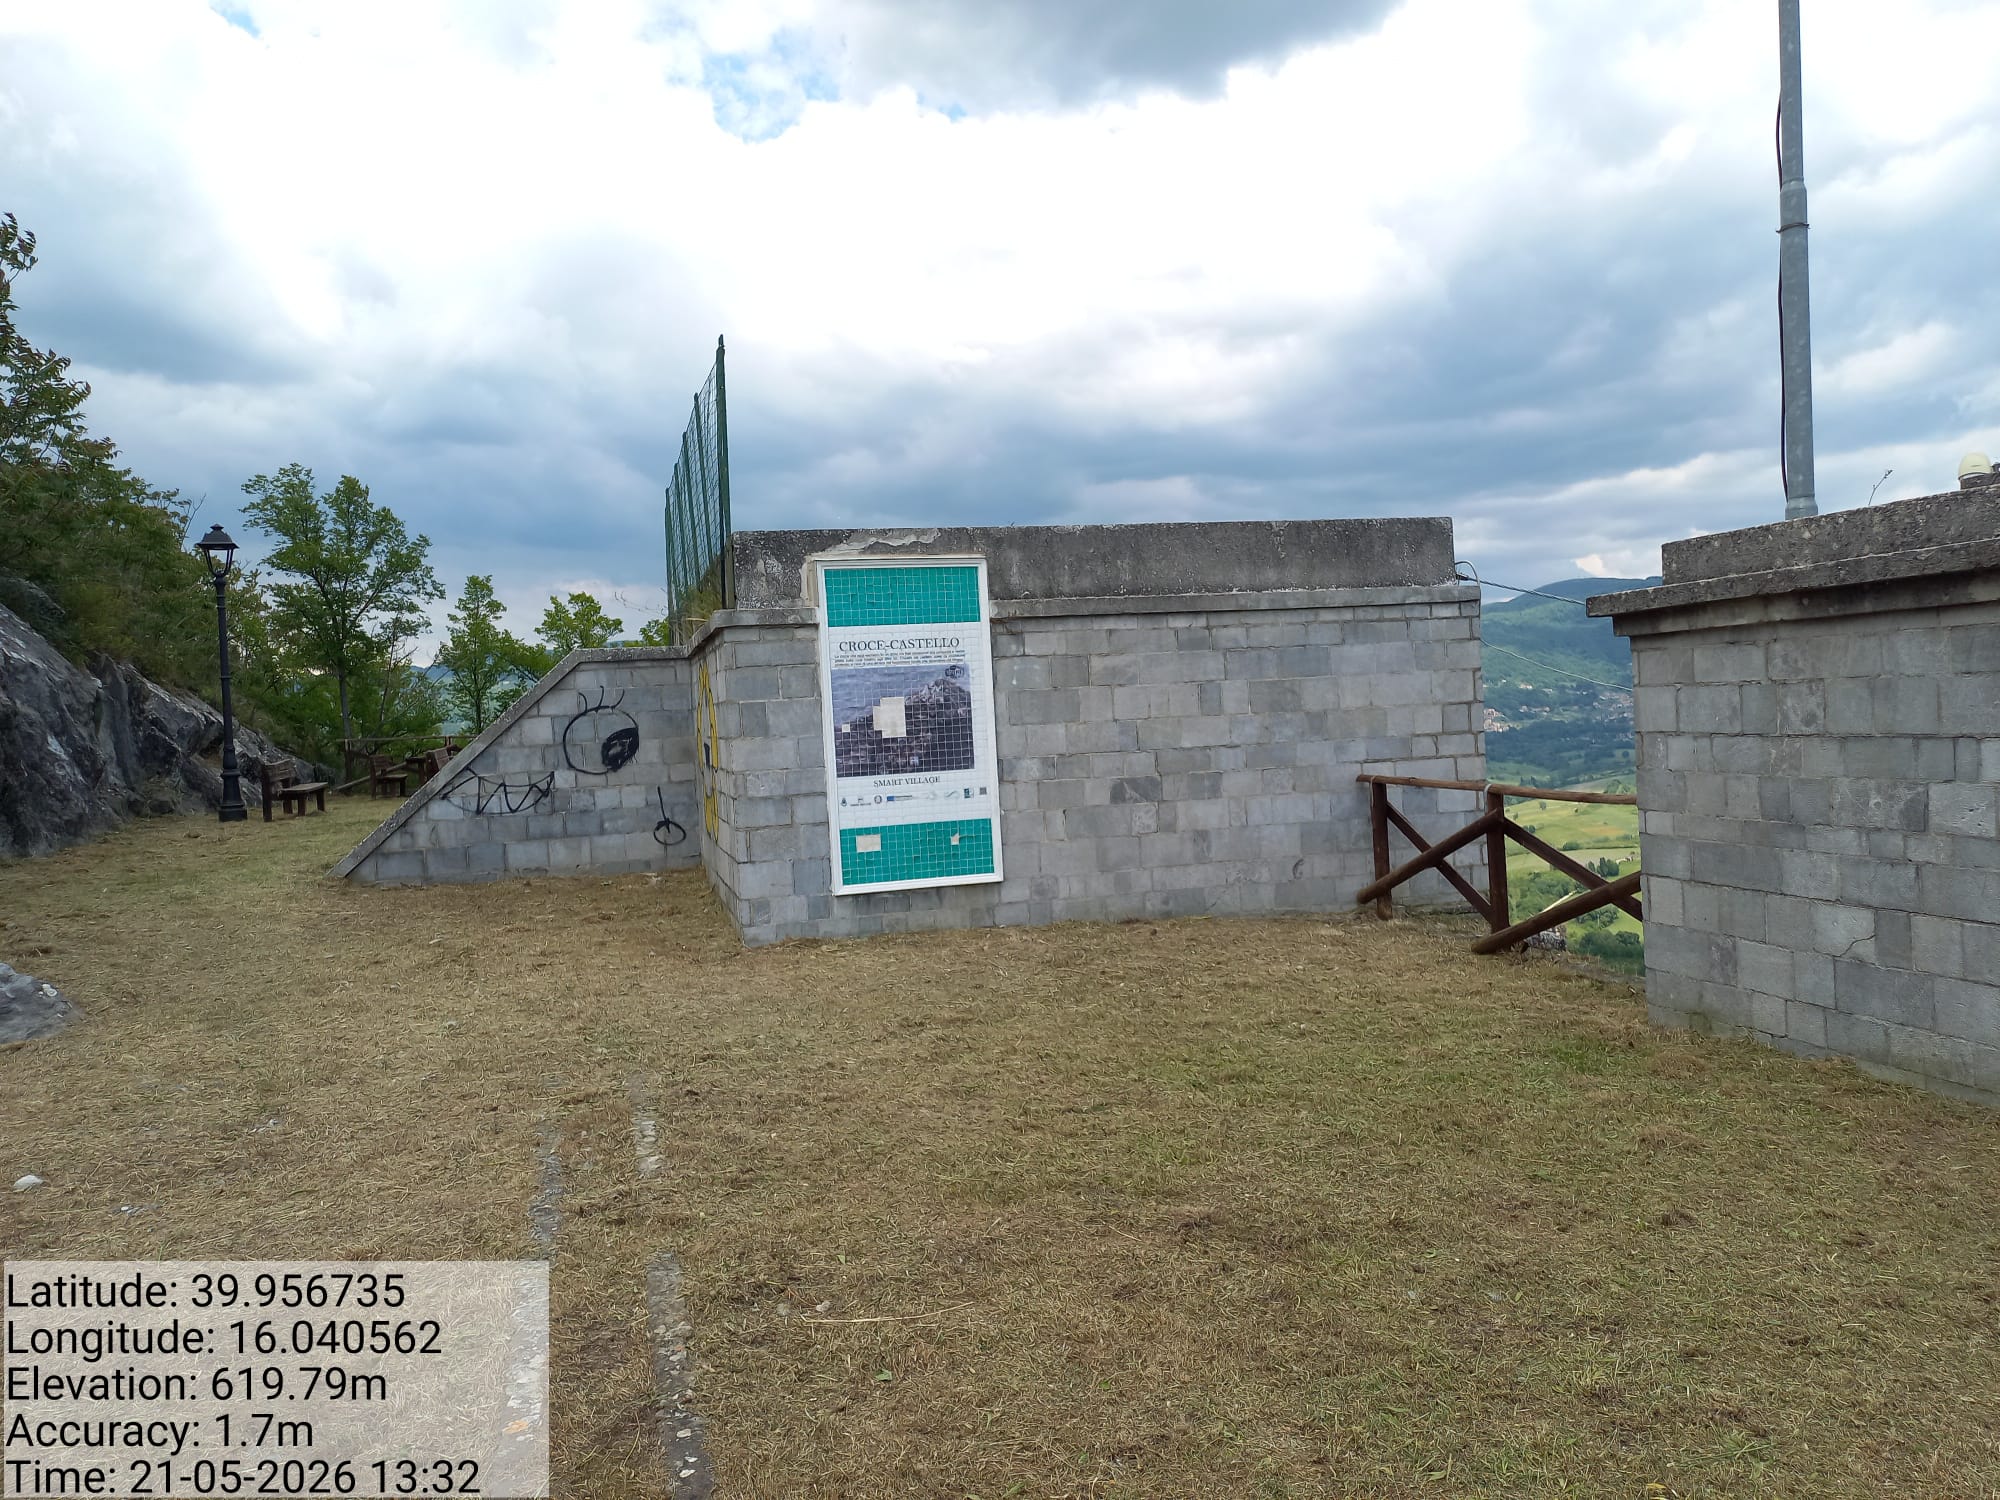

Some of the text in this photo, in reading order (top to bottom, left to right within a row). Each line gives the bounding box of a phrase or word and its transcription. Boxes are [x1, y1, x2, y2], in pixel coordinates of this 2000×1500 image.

[839, 637, 960, 652] CROCE-CASTELLO
[873, 776, 941, 788] SMART VILLAGE
